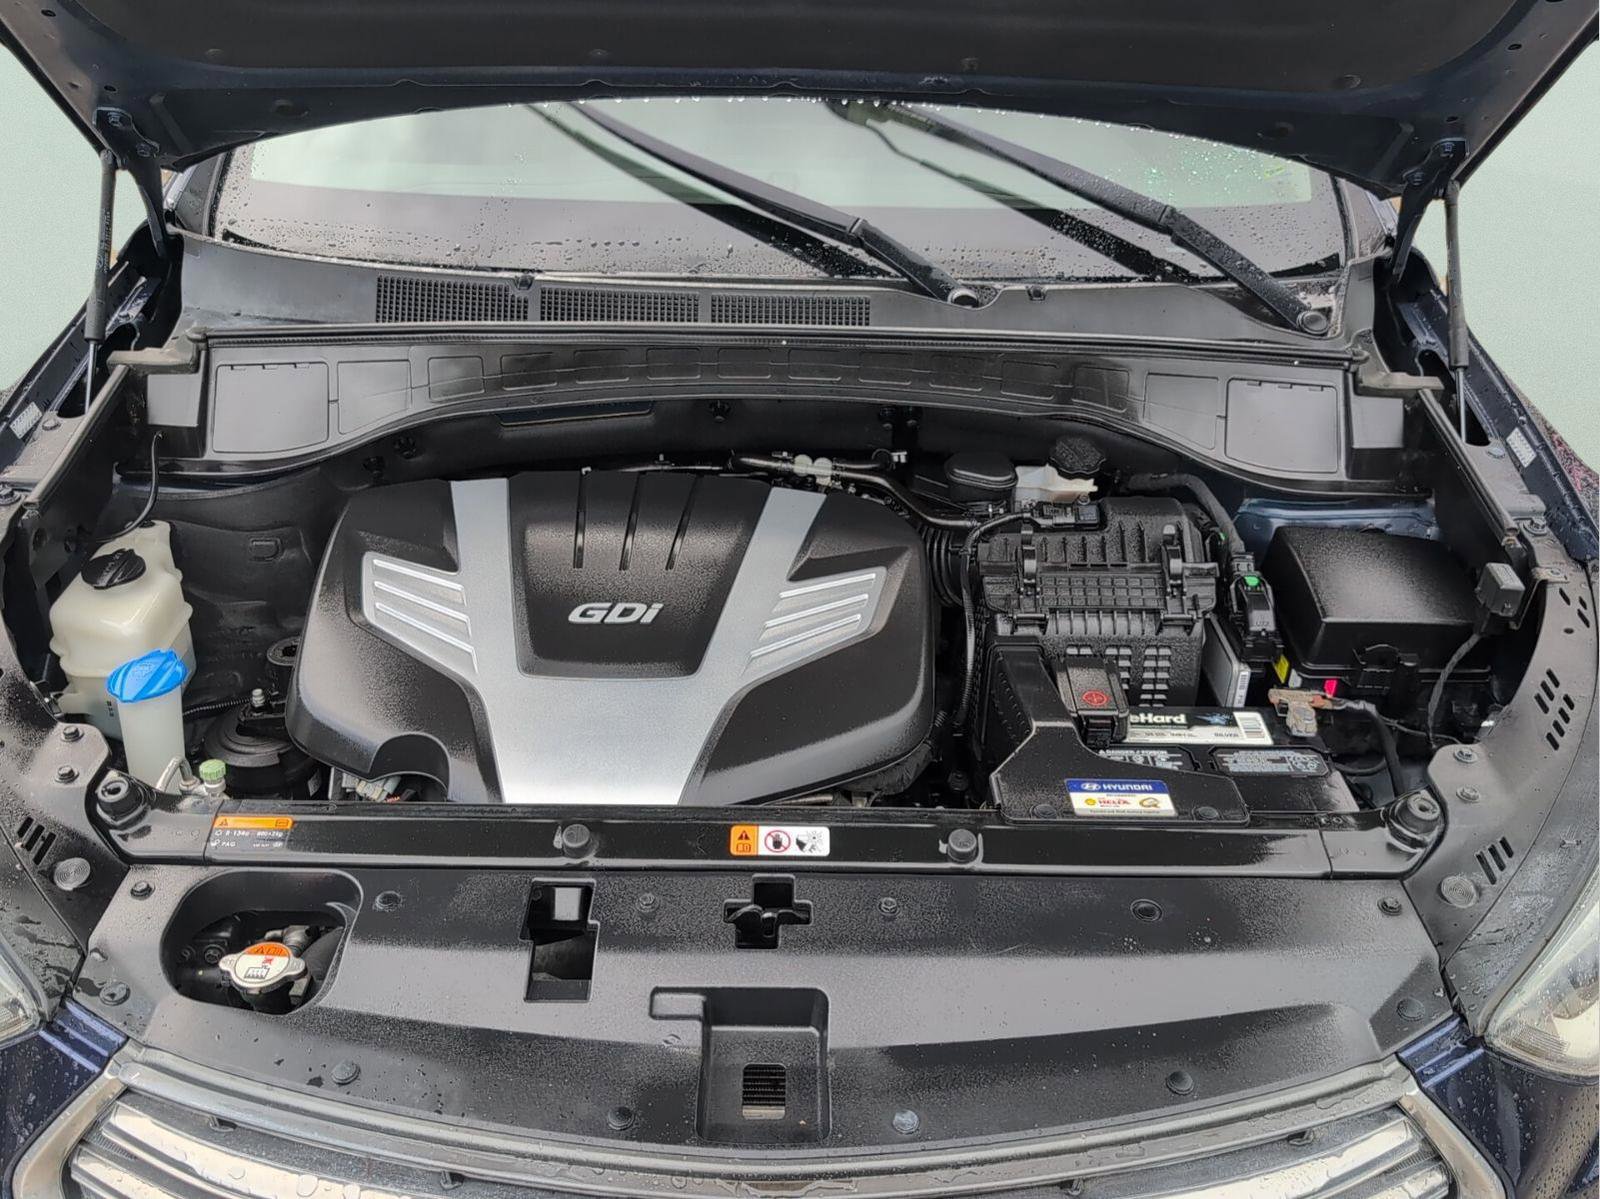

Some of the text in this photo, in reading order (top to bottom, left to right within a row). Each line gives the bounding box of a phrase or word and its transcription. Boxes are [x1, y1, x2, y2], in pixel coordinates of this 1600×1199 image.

[568, 602, 664, 624] GDi
[1129, 711, 1187, 724] eHard
[1102, 783, 1153, 791] HYUNDAI
